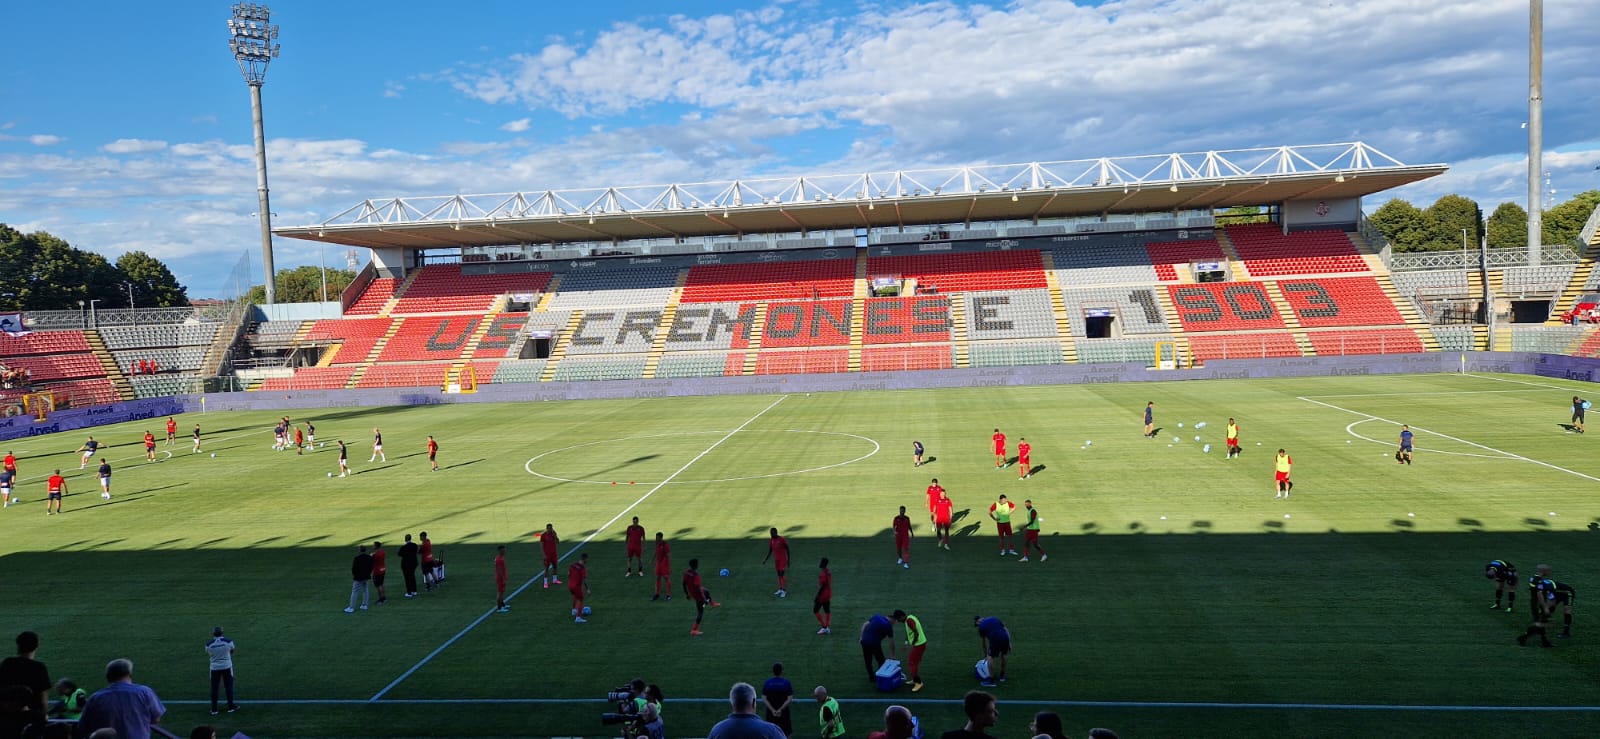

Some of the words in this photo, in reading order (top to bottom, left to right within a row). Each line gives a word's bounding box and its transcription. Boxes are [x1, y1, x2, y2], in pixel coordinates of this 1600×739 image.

[426, 316, 529, 350] US
[572, 296, 1014, 345] CREMONESE
[1129, 283, 1339, 324] 1903
[1331, 366, 1369, 376] Arvedi
[1082, 375, 1119, 384] Arvedi
[851, 382, 886, 391] Arvedi
[129, 410, 155, 421] Arvedi
[28, 422, 59, 436] Arvedi
